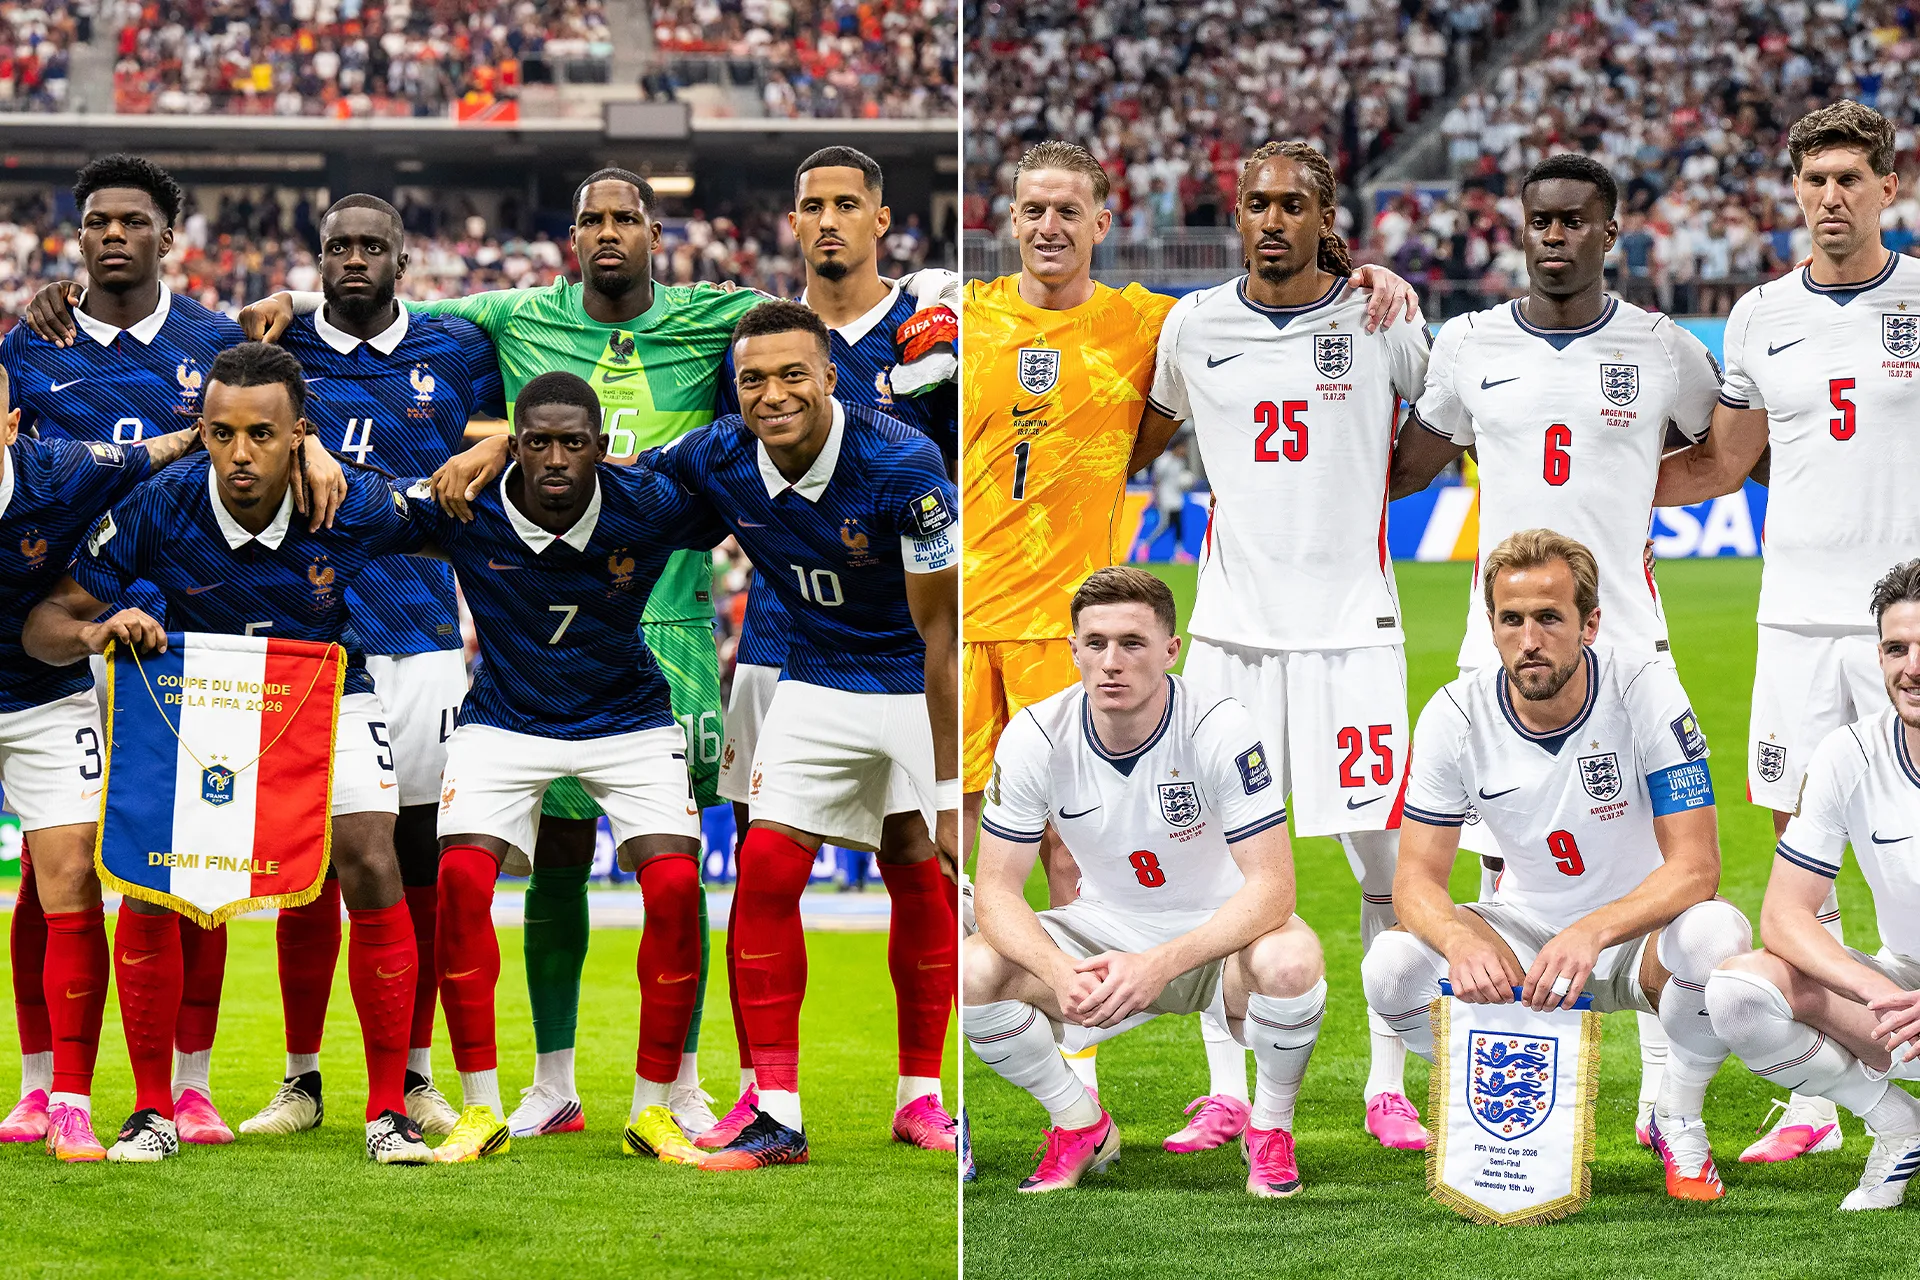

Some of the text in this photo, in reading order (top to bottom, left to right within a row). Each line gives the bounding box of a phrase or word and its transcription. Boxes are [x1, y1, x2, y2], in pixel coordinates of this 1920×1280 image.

[904, 314, 958, 339] FIFA WO
[1882, 361, 1920, 369] ARGENTINA
[1600, 409, 1637, 419] ARGENTINA
[1829, 377, 1856, 441] 5
[341, 418, 373, 464] 4
[1254, 400, 1308, 462] 25
[1543, 423, 1572, 486] 6
[1013, 441, 1031, 500] 1
[1651, 490, 1756, 559] SA
[913, 544, 955, 563] the World
[914, 534, 949, 553] UNITES
[930, 560, 946, 569] FIFA
[790, 564, 844, 606] 10
[548, 605, 578, 644] 7
[157, 674, 292, 696] COUPE DU MONDE
[164, 692, 283, 713] DE LA FIFA 2026
[368, 722, 394, 771] 5
[680, 710, 720, 766] 16
[75, 726, 101, 780] 3
[1337, 724, 1393, 788] 25
[1667, 764, 1703, 779] FOOTBALL
[1669, 772, 1707, 791] UNITES
[1669, 784, 1710, 801] the World
[1591, 800, 1628, 815] ARGENTINA
[1169, 821, 1206, 839] ARGENTINA
[148, 852, 280, 875] DEMI FINALE
[1546, 829, 1585, 876] 9
[1128, 850, 1166, 888] 8
[1474, 1144, 1538, 1157] FIFA World Cup 2026
[1490, 1158, 1521, 1167] Semi-Final
[1482, 1169, 1527, 1180] Atlanta Stadium
[1474, 1179, 1506, 1191] Wednesday
[1522, 1185, 1535, 1194] July
